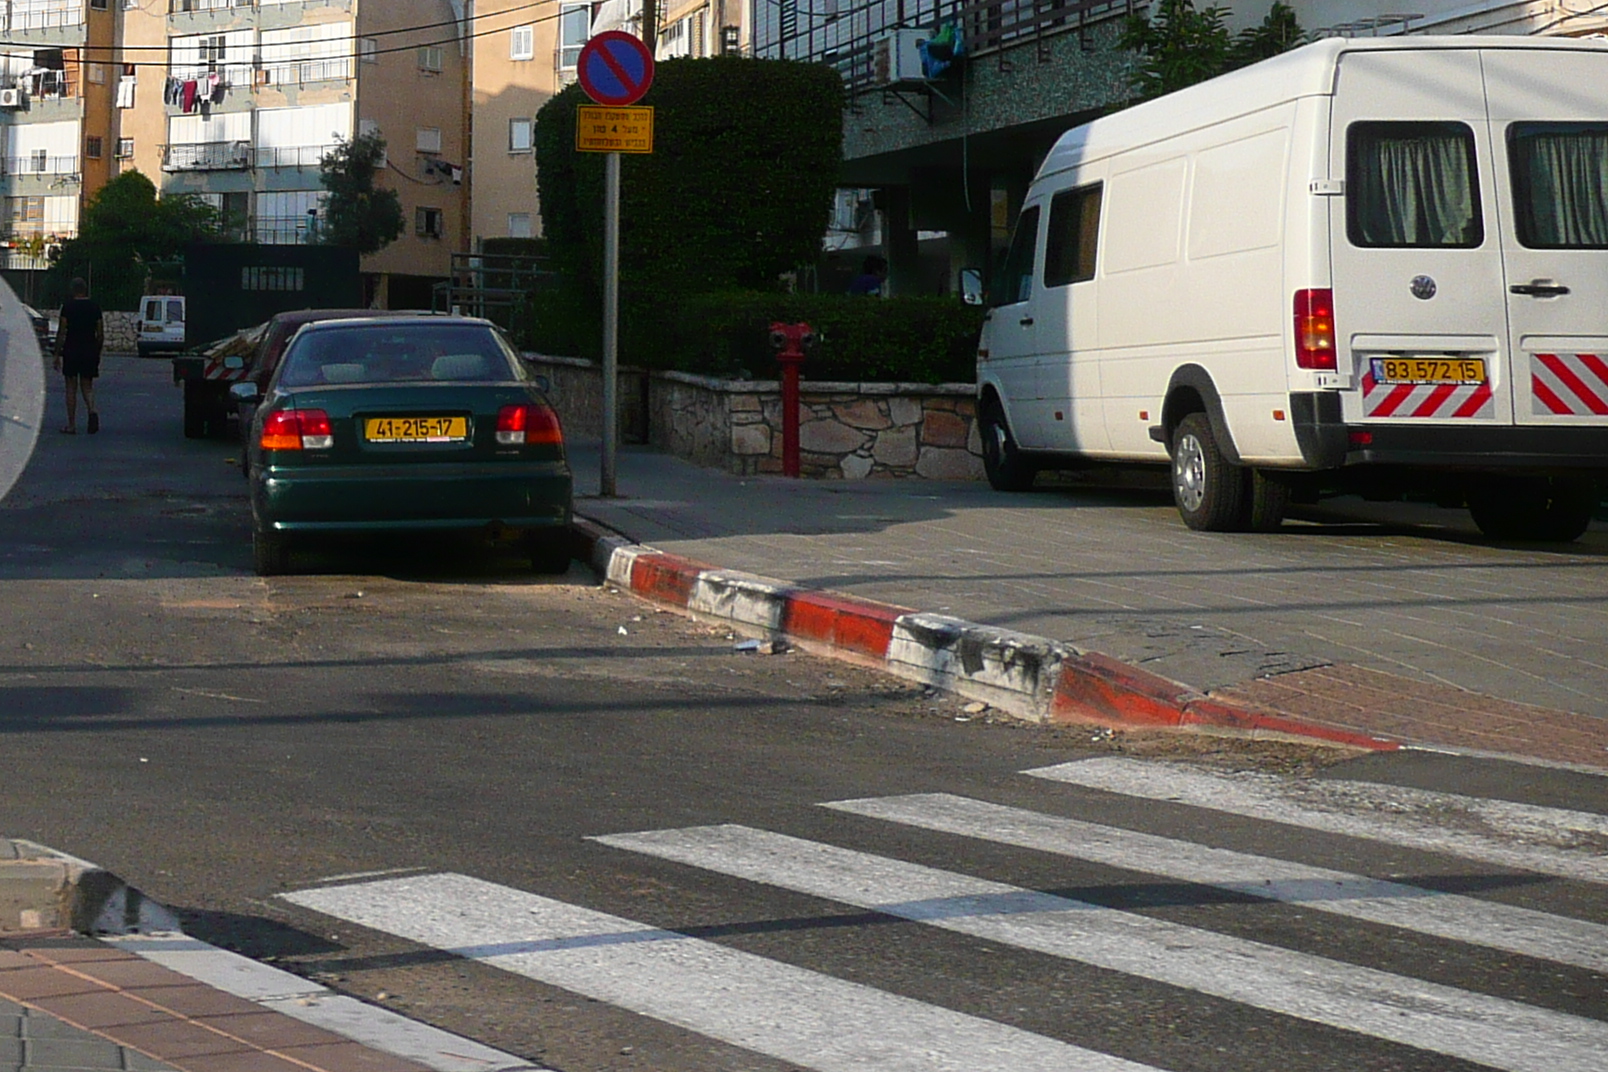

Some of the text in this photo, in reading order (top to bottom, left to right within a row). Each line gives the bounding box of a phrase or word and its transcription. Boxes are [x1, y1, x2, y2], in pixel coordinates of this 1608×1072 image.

[593, 125, 606, 134] טון
[611, 125, 618, 133] 4
[376, 418, 453, 437] 41-215-17
